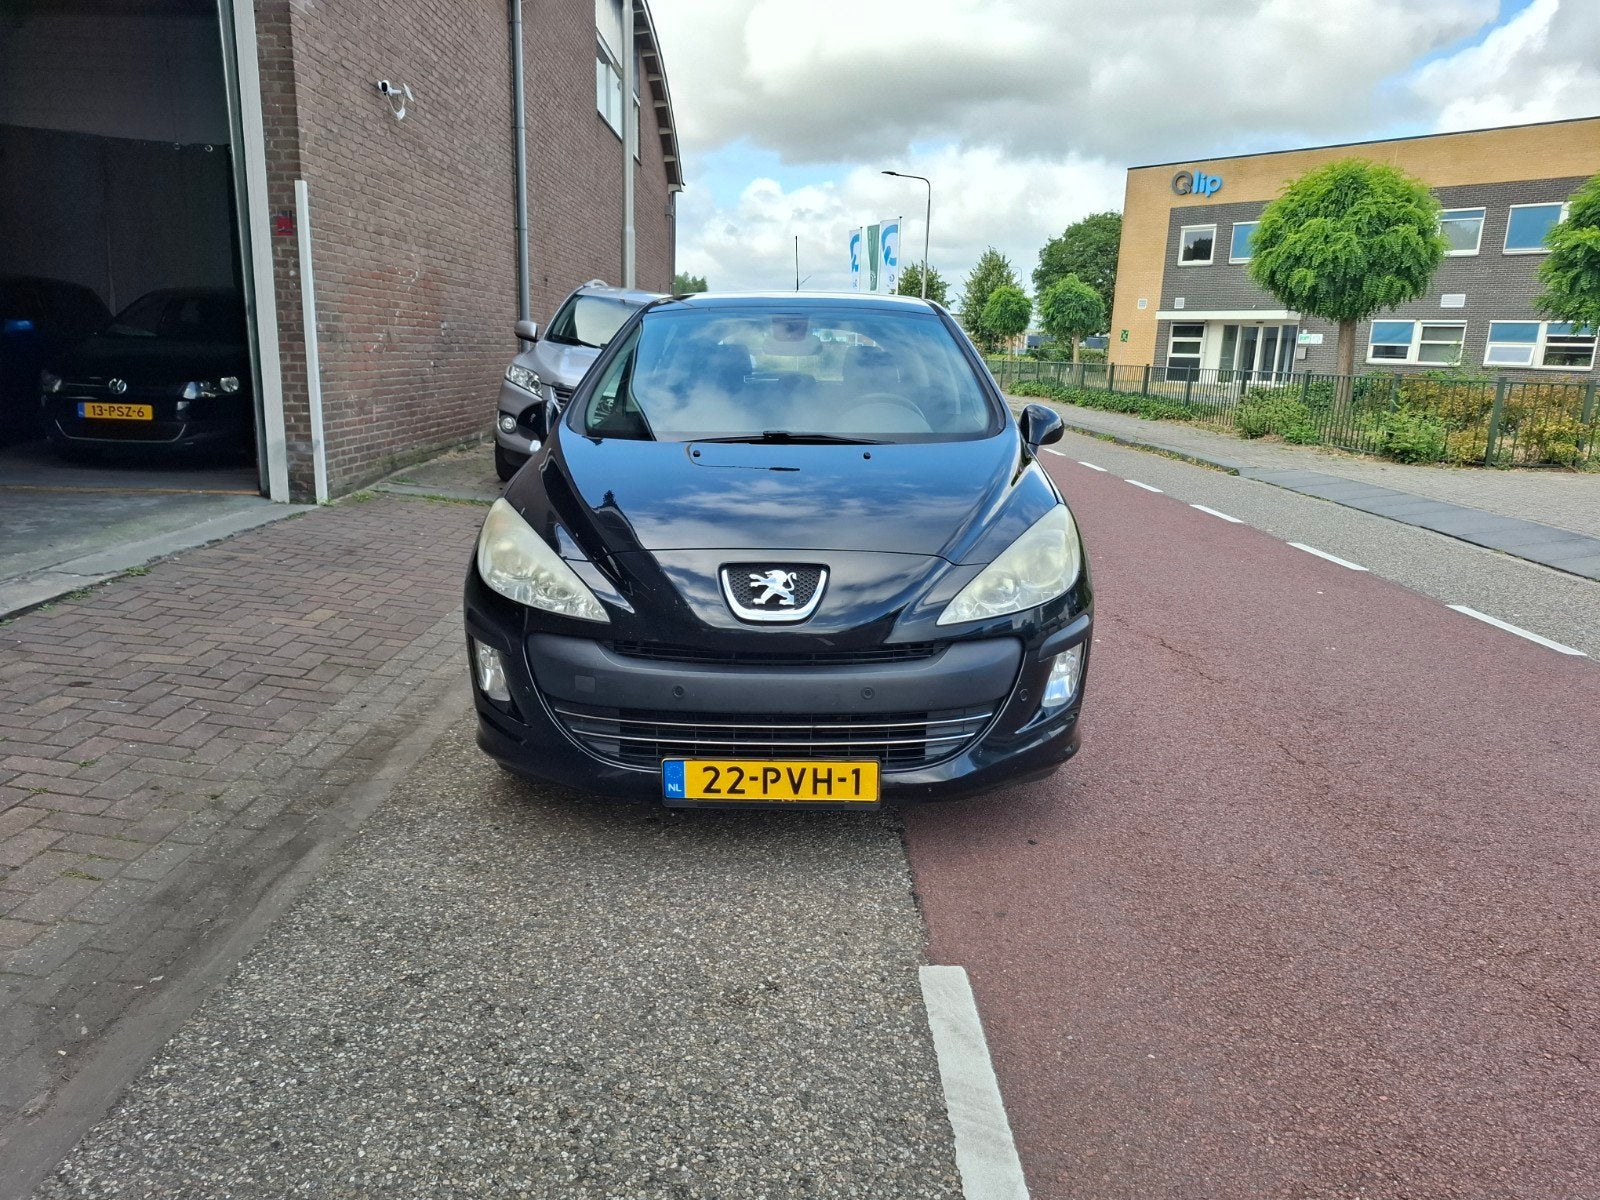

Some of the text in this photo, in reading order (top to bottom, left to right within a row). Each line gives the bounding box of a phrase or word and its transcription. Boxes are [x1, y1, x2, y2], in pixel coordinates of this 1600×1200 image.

[1172, 169, 1223, 198] Qlip
[91, 405, 145, 418] 13-PSZ-6
[668, 783, 682, 792] NL
[702, 765, 861, 796] 22-PVH-1
